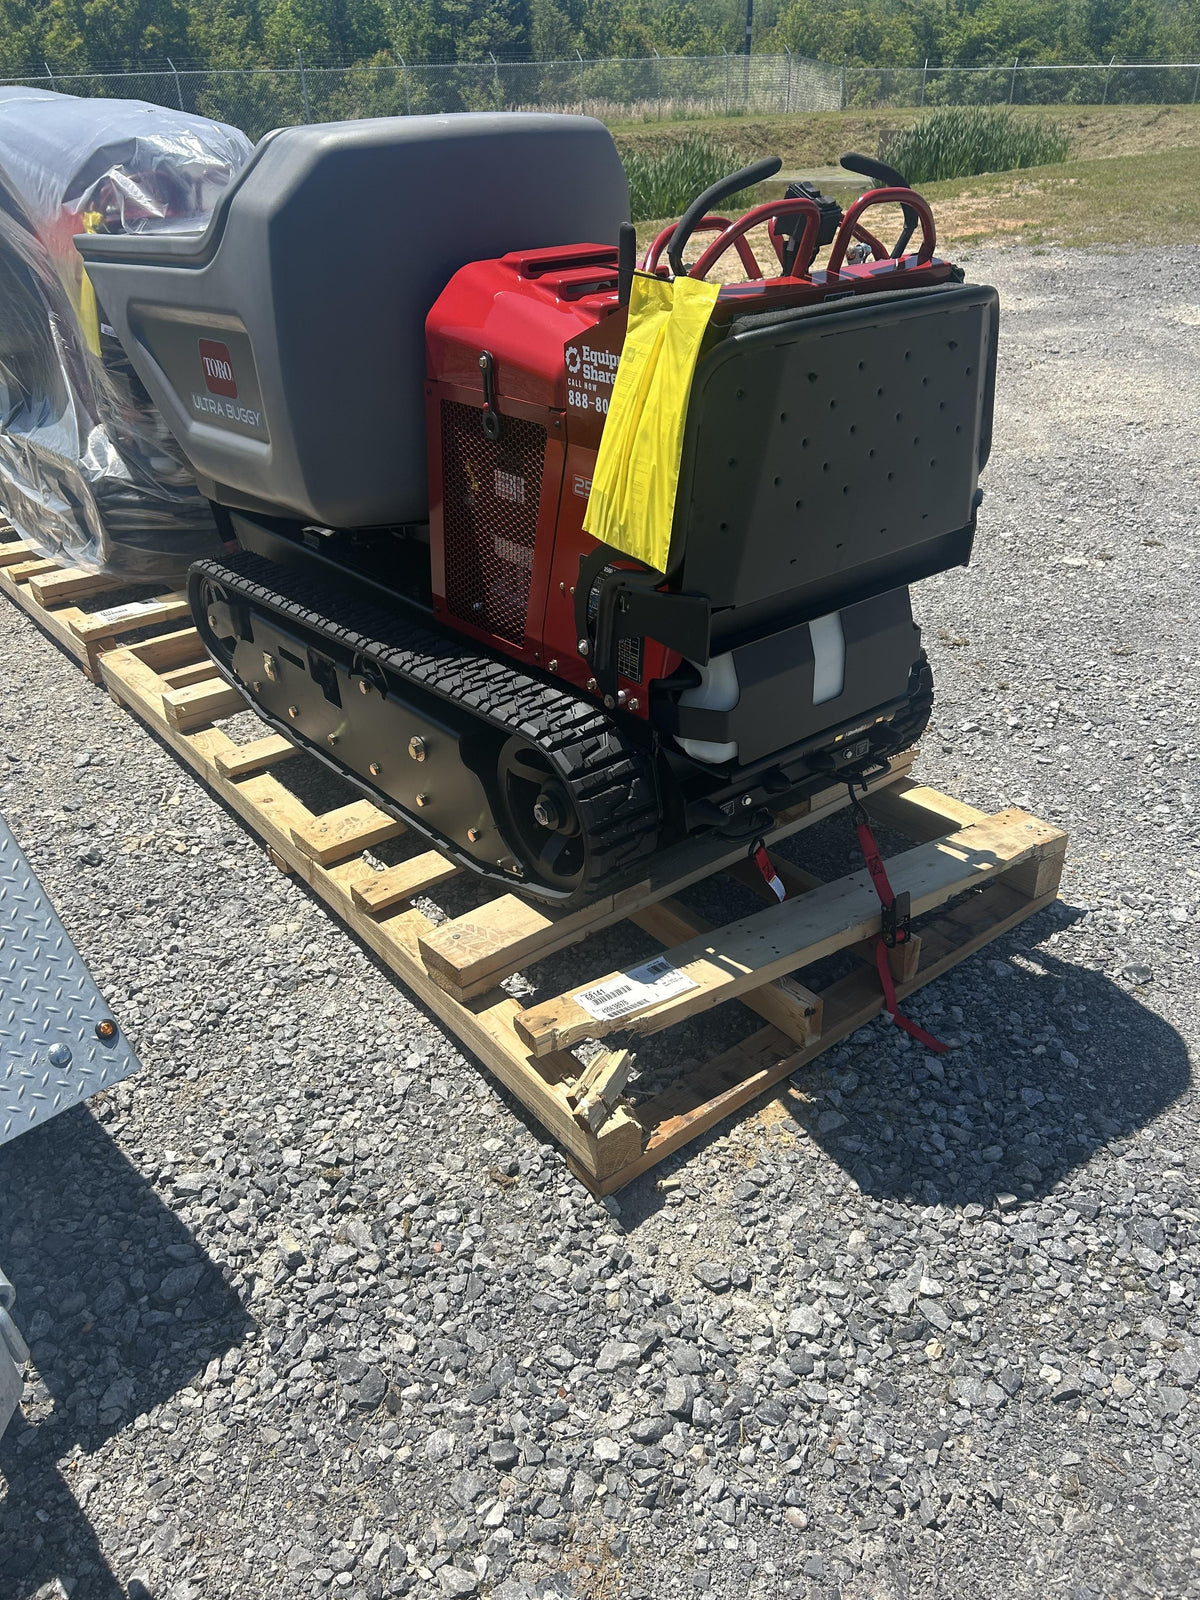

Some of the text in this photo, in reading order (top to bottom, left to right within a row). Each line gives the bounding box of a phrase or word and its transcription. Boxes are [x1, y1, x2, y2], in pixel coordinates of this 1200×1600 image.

[203, 357, 233, 381] TORO
[583, 364, 616, 385] Share
[567, 378, 597, 392] CALL NOW
[192, 394, 261, 426] ULTRA BUGGY
[584, 988, 606, 1001] 68141
